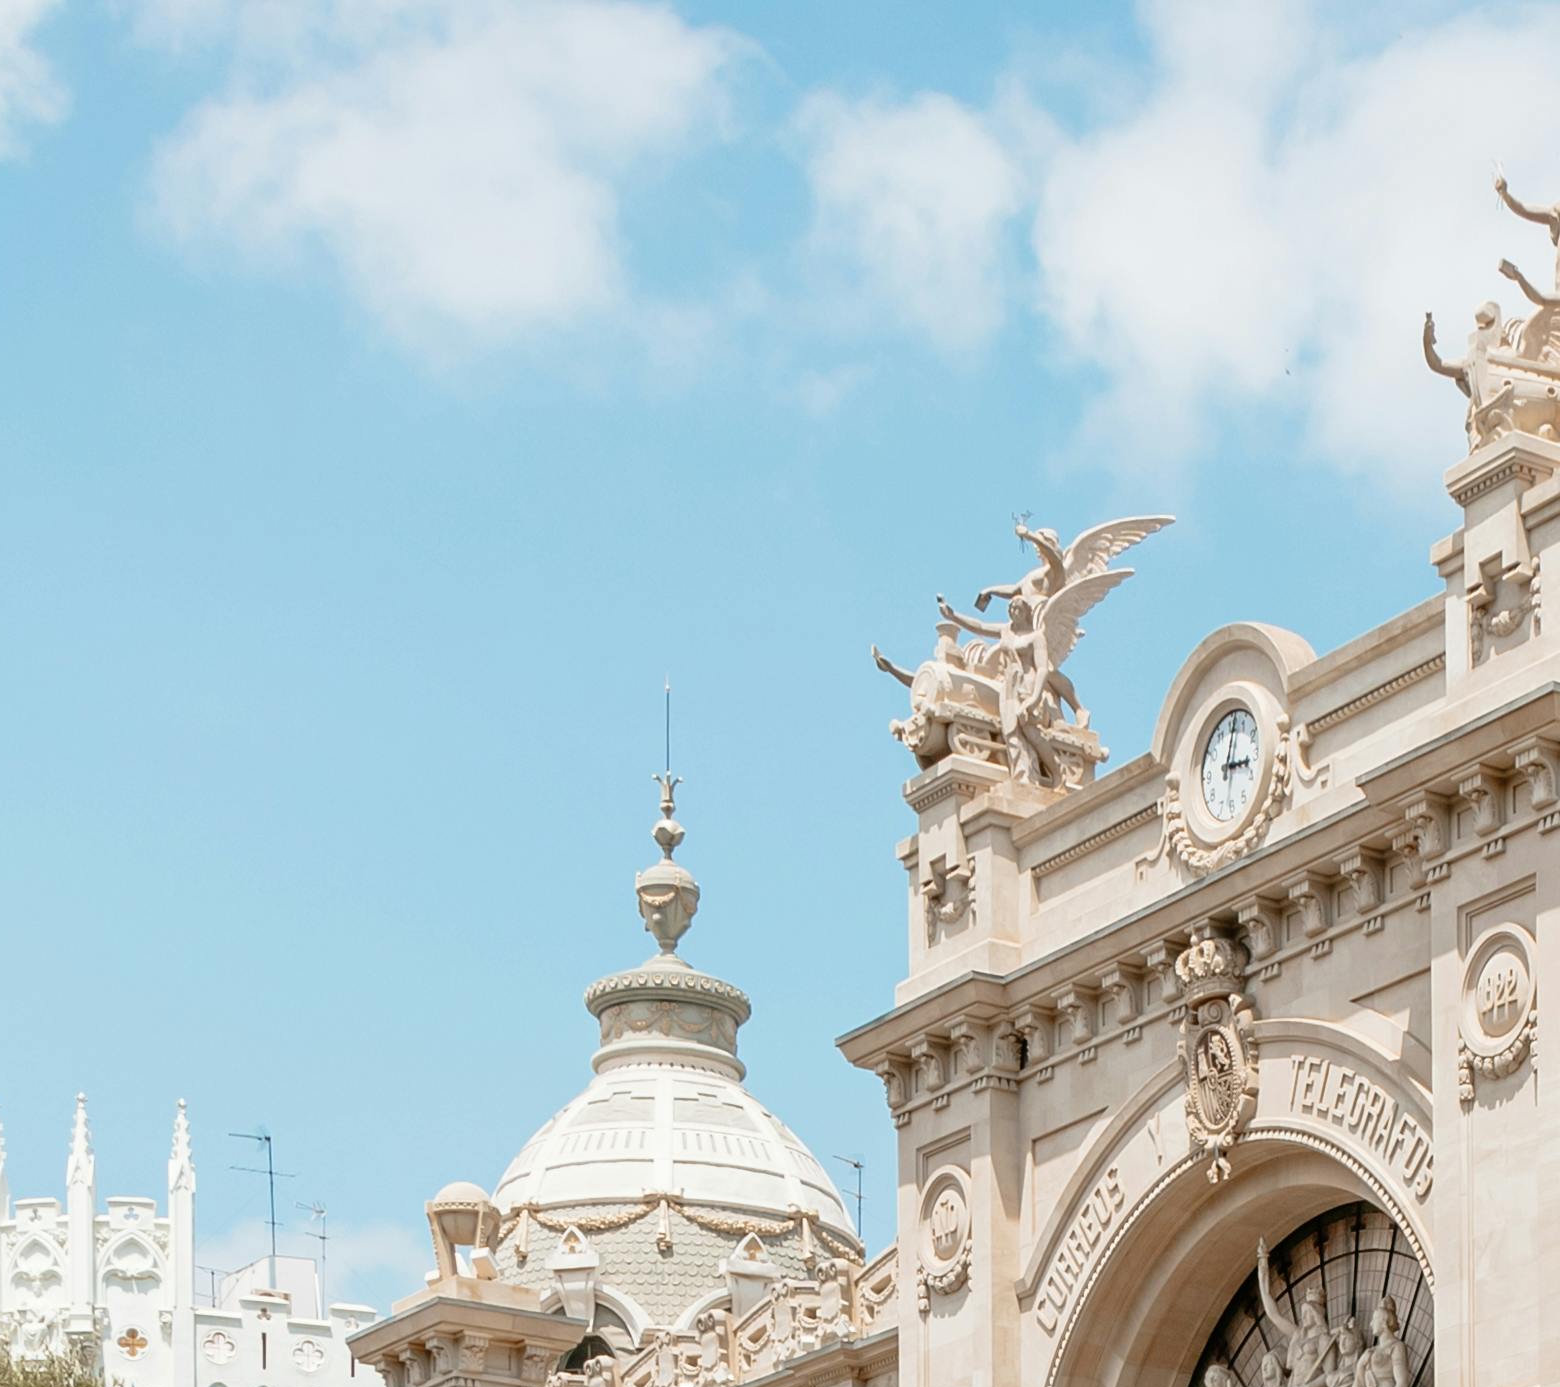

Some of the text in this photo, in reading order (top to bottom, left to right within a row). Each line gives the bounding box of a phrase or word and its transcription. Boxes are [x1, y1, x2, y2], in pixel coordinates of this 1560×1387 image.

[1240, 789, 1247, 804] 5
[1146, 1111, 1167, 1166] Y
[1291, 1054, 1434, 1198] TELEGRAFOS
